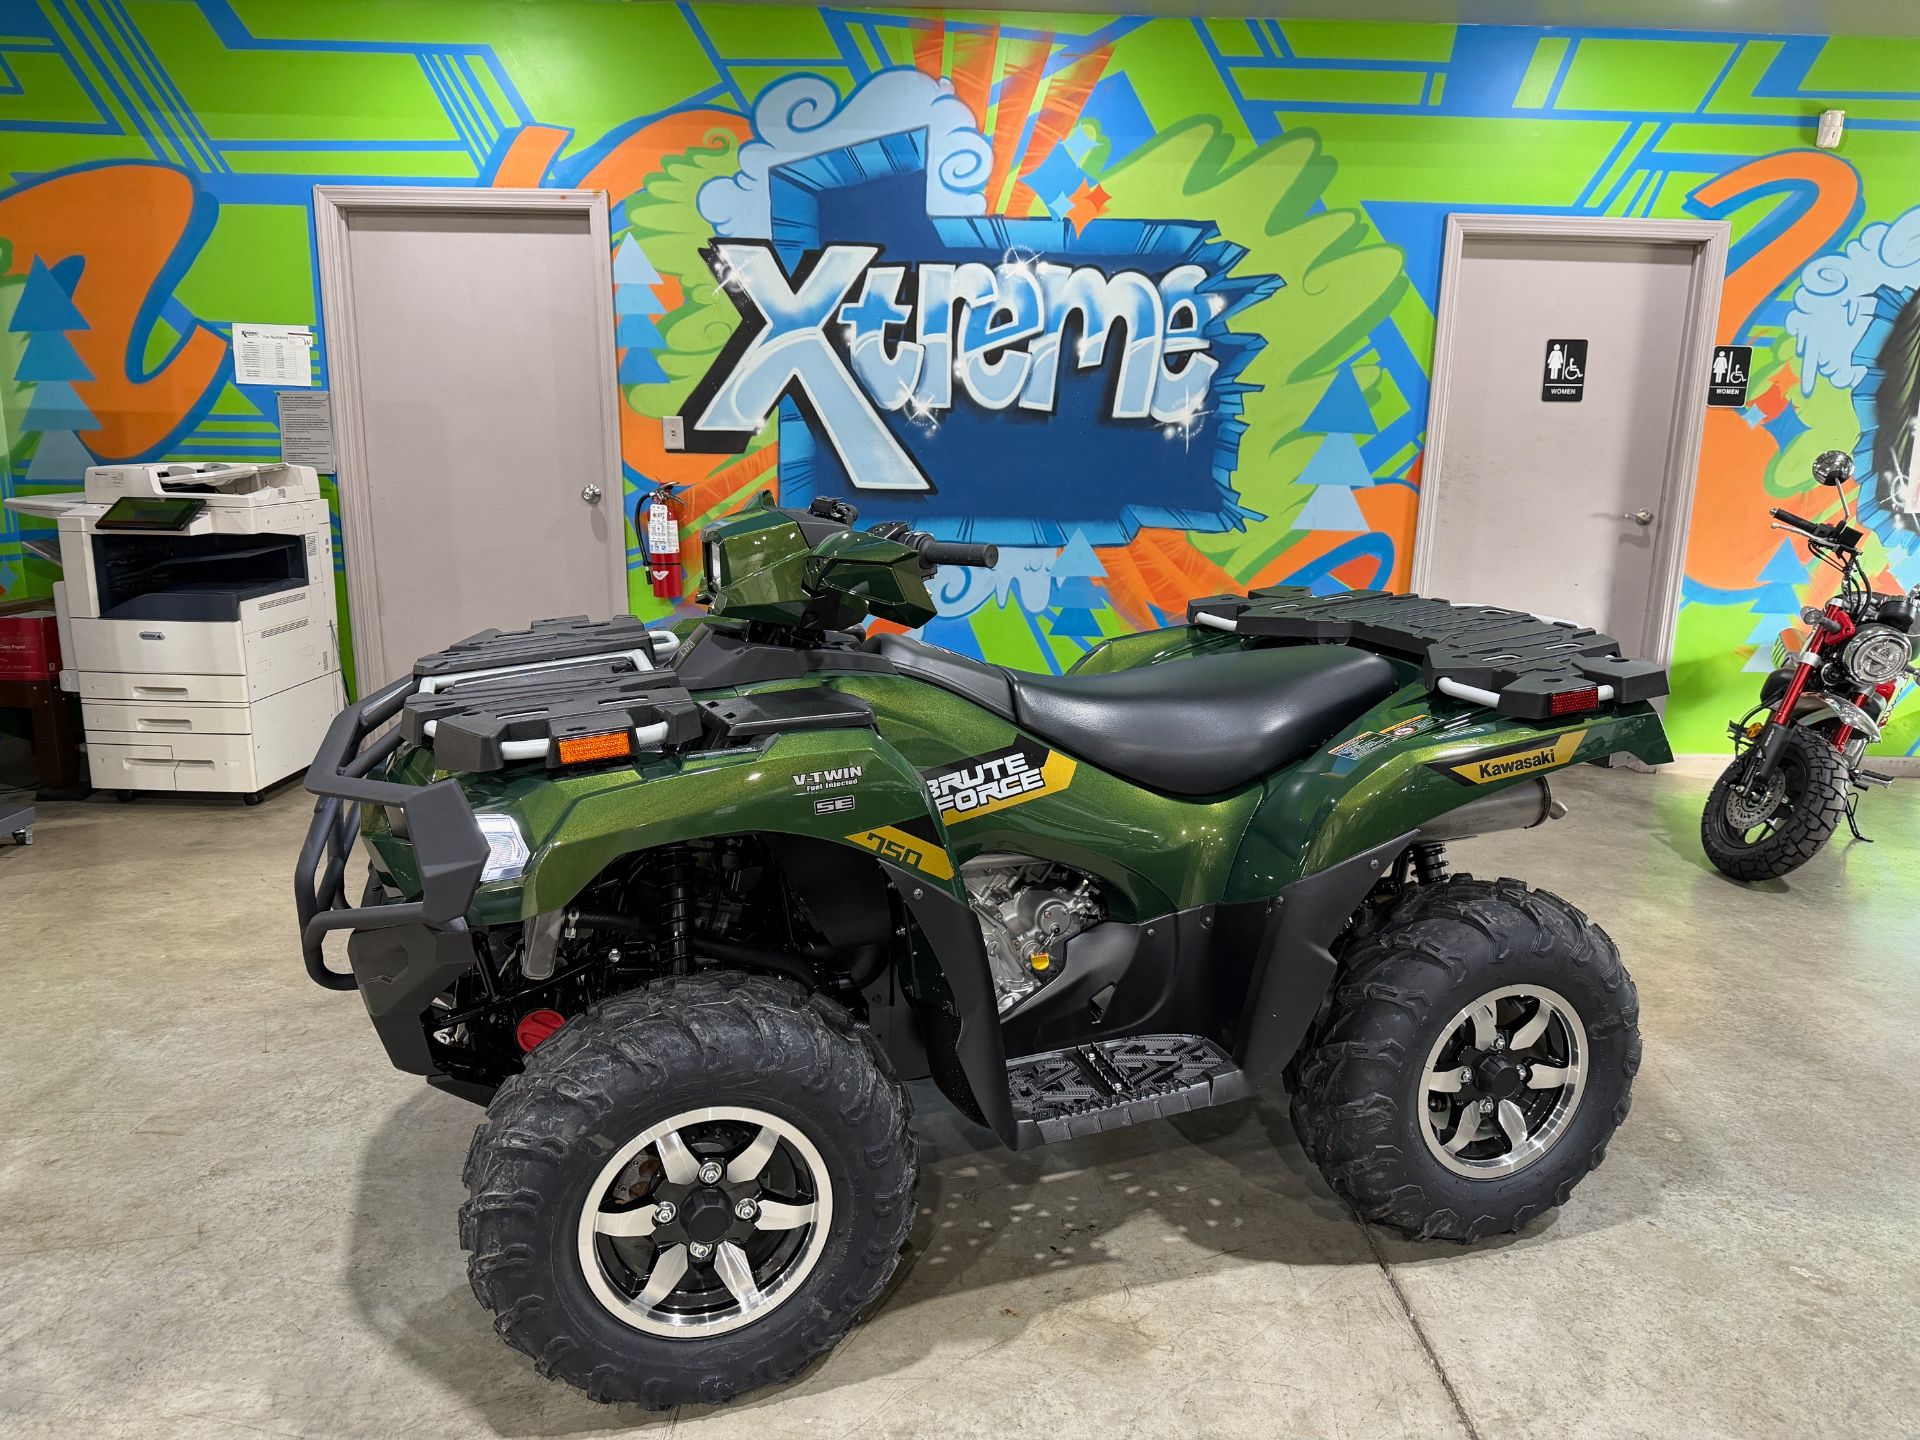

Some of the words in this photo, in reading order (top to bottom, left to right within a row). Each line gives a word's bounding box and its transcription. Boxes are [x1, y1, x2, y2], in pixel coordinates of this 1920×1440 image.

[694, 242, 1220, 491] Xtreme
[792, 765, 863, 786] V-TWIN
[926, 752, 1029, 797] BRUTE
[1479, 749, 1556, 778] Kawasaki
[806, 784, 824, 792] Fuel
[825, 778, 859, 789] Injected
[934, 768, 1046, 815] FORCE
[816, 798, 853, 813] SE
[866, 832, 923, 869] 750
